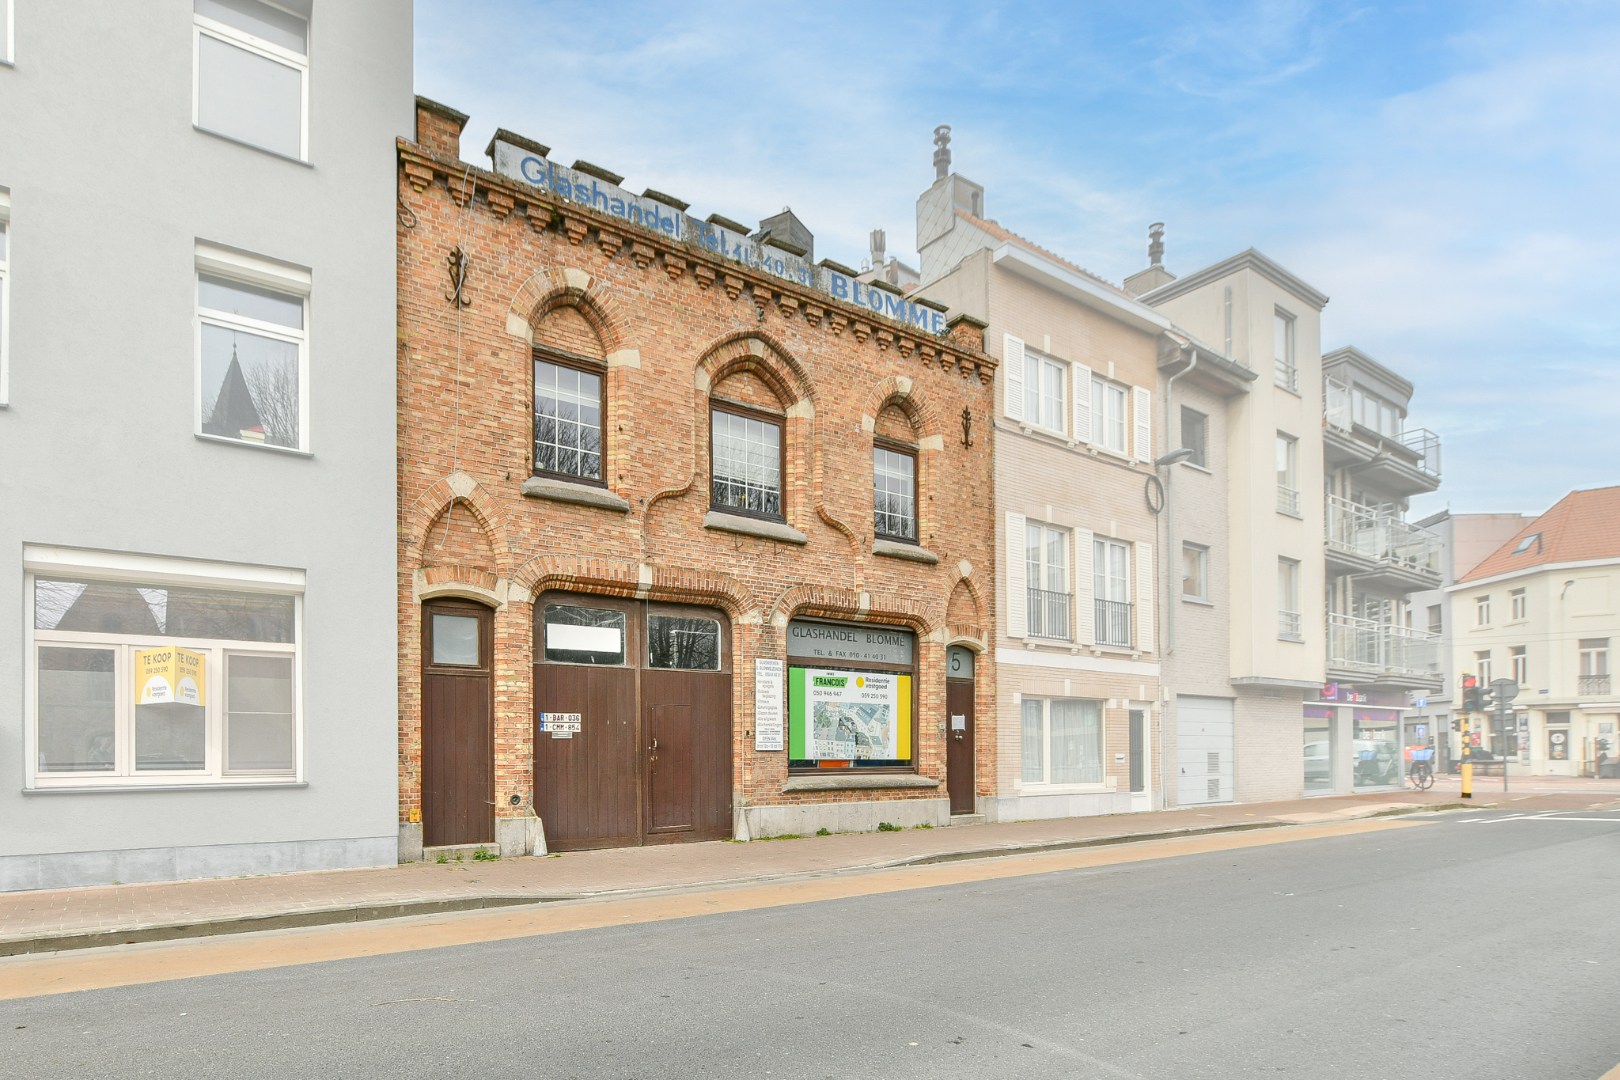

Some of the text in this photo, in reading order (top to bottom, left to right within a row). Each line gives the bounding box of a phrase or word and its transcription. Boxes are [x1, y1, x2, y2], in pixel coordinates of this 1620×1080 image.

[521, 156, 680, 239] Glashandel
[831, 273, 944, 335] BLOMME
[792, 626, 905, 647] GLASHANDEL BLOMME
[143, 652, 172, 665] TE KOOP
[177, 652, 185, 664] TE
[951, 652, 961, 672] 5
